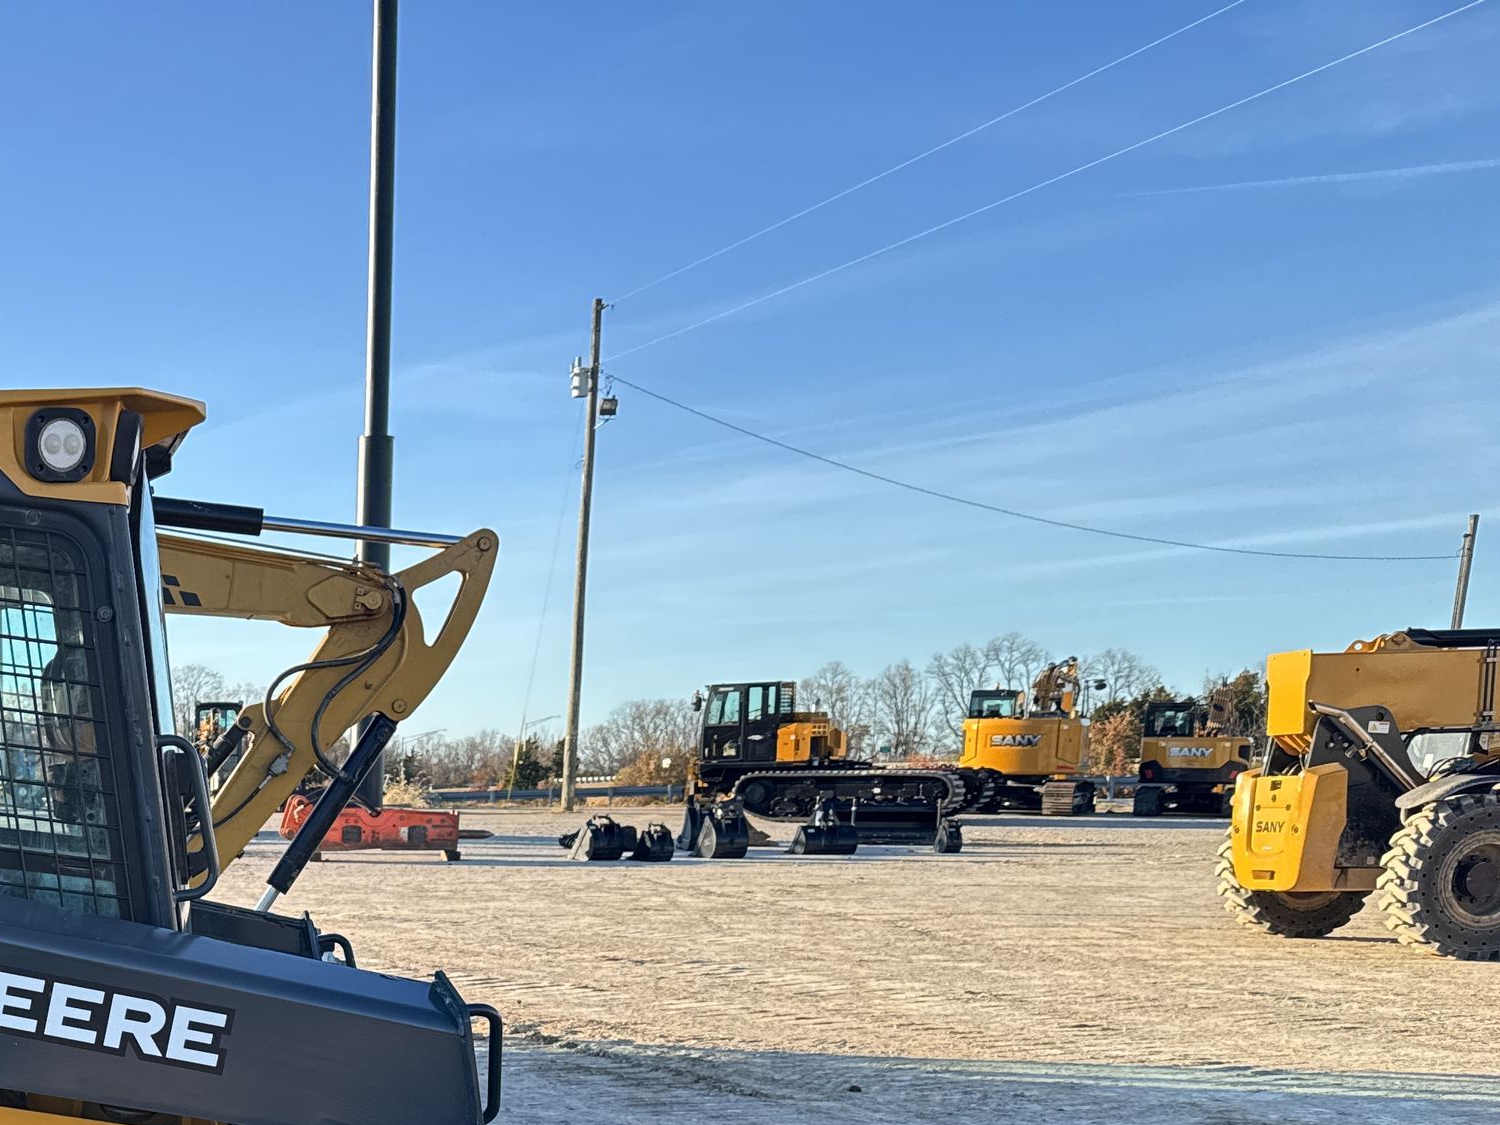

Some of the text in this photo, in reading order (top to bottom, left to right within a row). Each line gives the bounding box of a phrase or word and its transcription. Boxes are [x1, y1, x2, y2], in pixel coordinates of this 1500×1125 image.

[990, 734, 1043, 747] SANY
[1169, 746, 1214, 757] SANY
[1255, 820, 1286, 833] SANY
